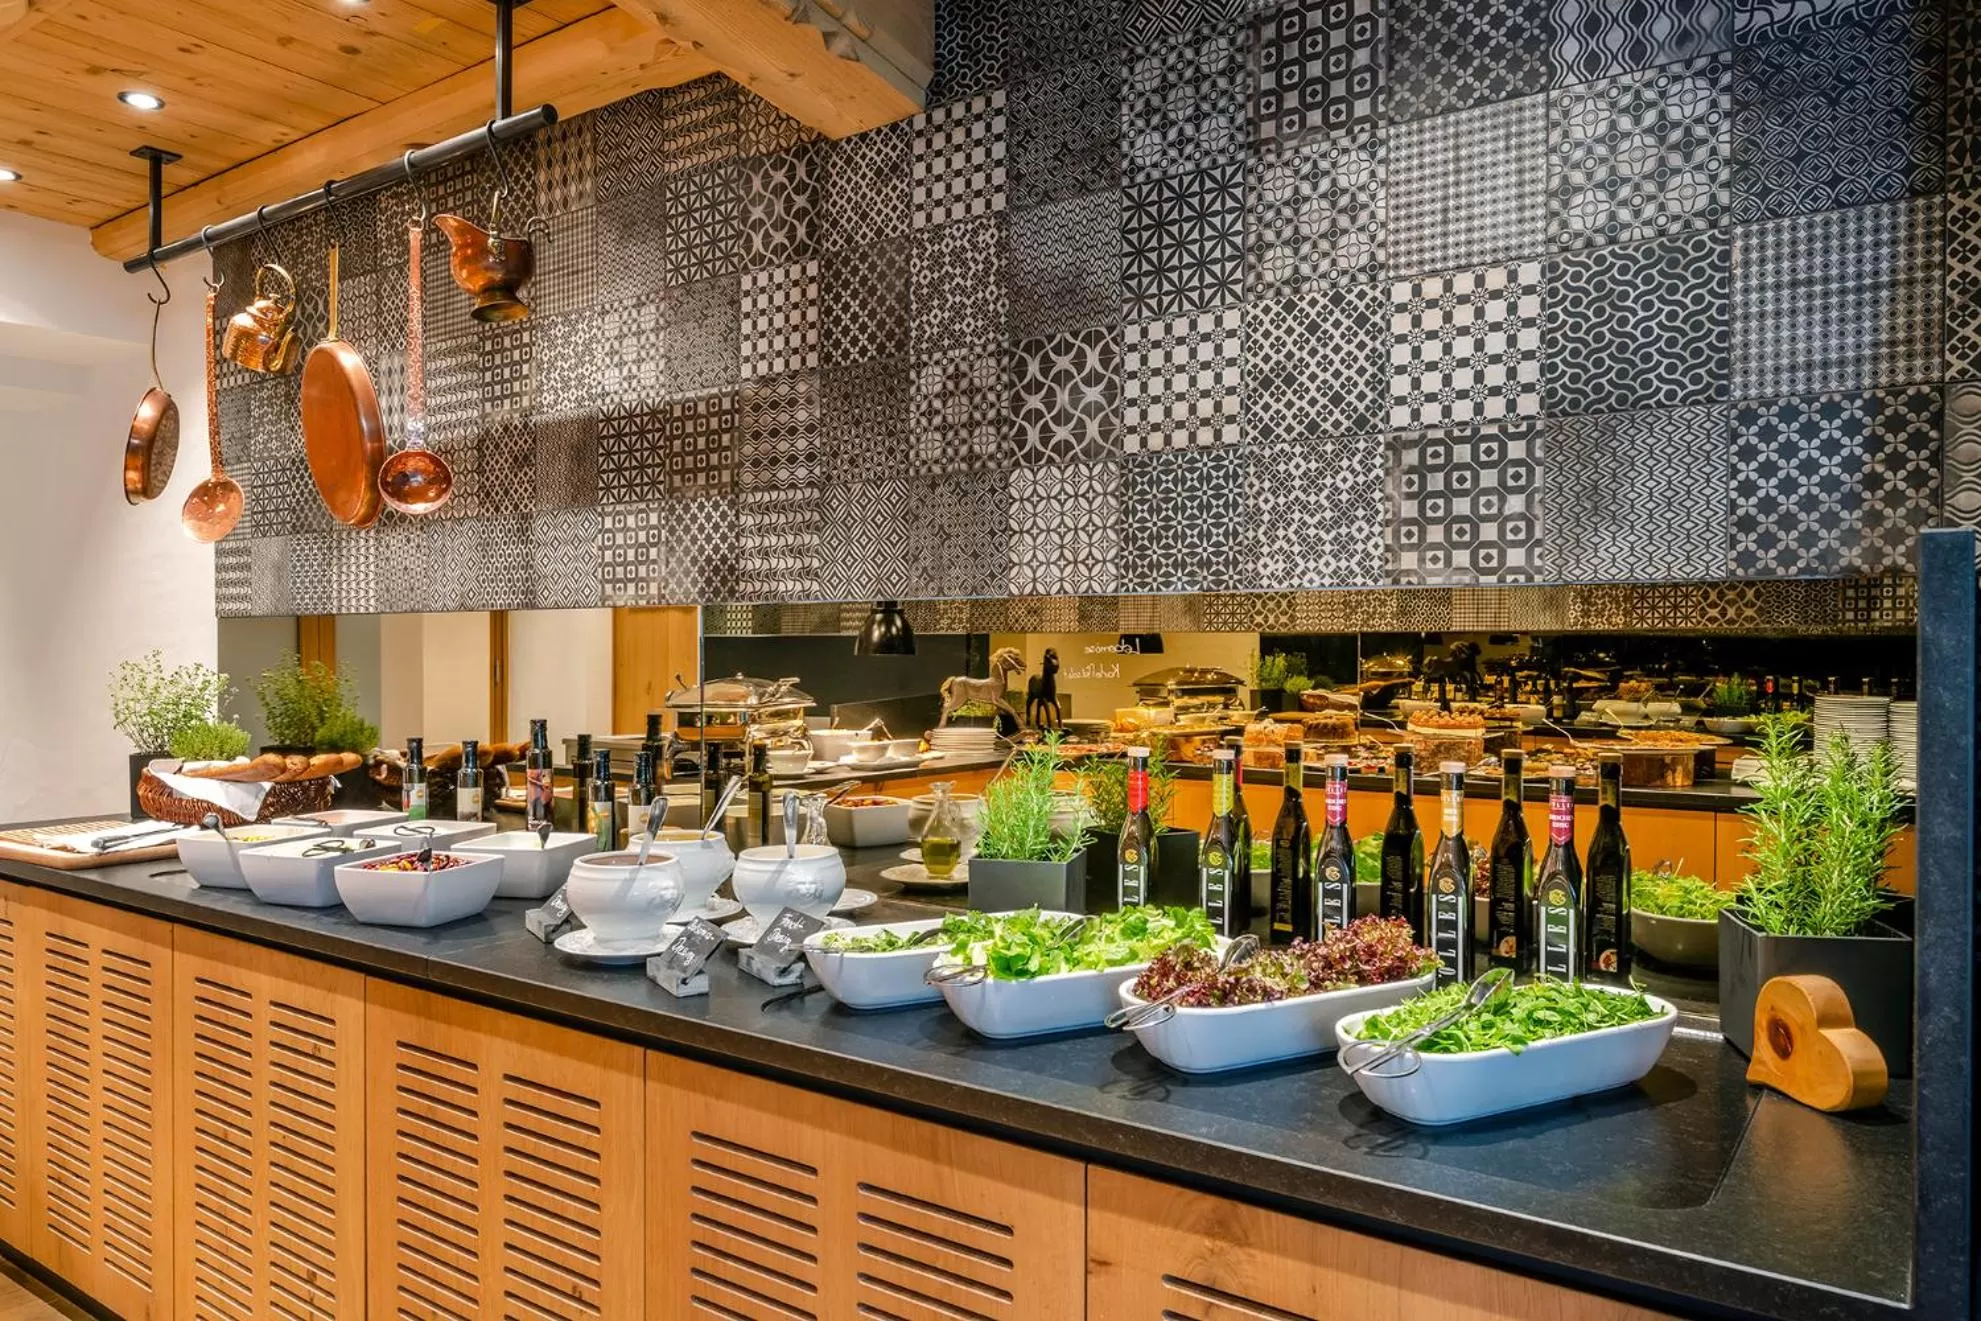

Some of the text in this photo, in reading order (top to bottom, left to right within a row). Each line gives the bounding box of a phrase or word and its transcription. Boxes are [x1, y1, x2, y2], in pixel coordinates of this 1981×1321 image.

[1208, 868, 1224, 925] LLES
[1438, 894, 1456, 977] ÖLLES
[1547, 907, 1567, 973] LLES
